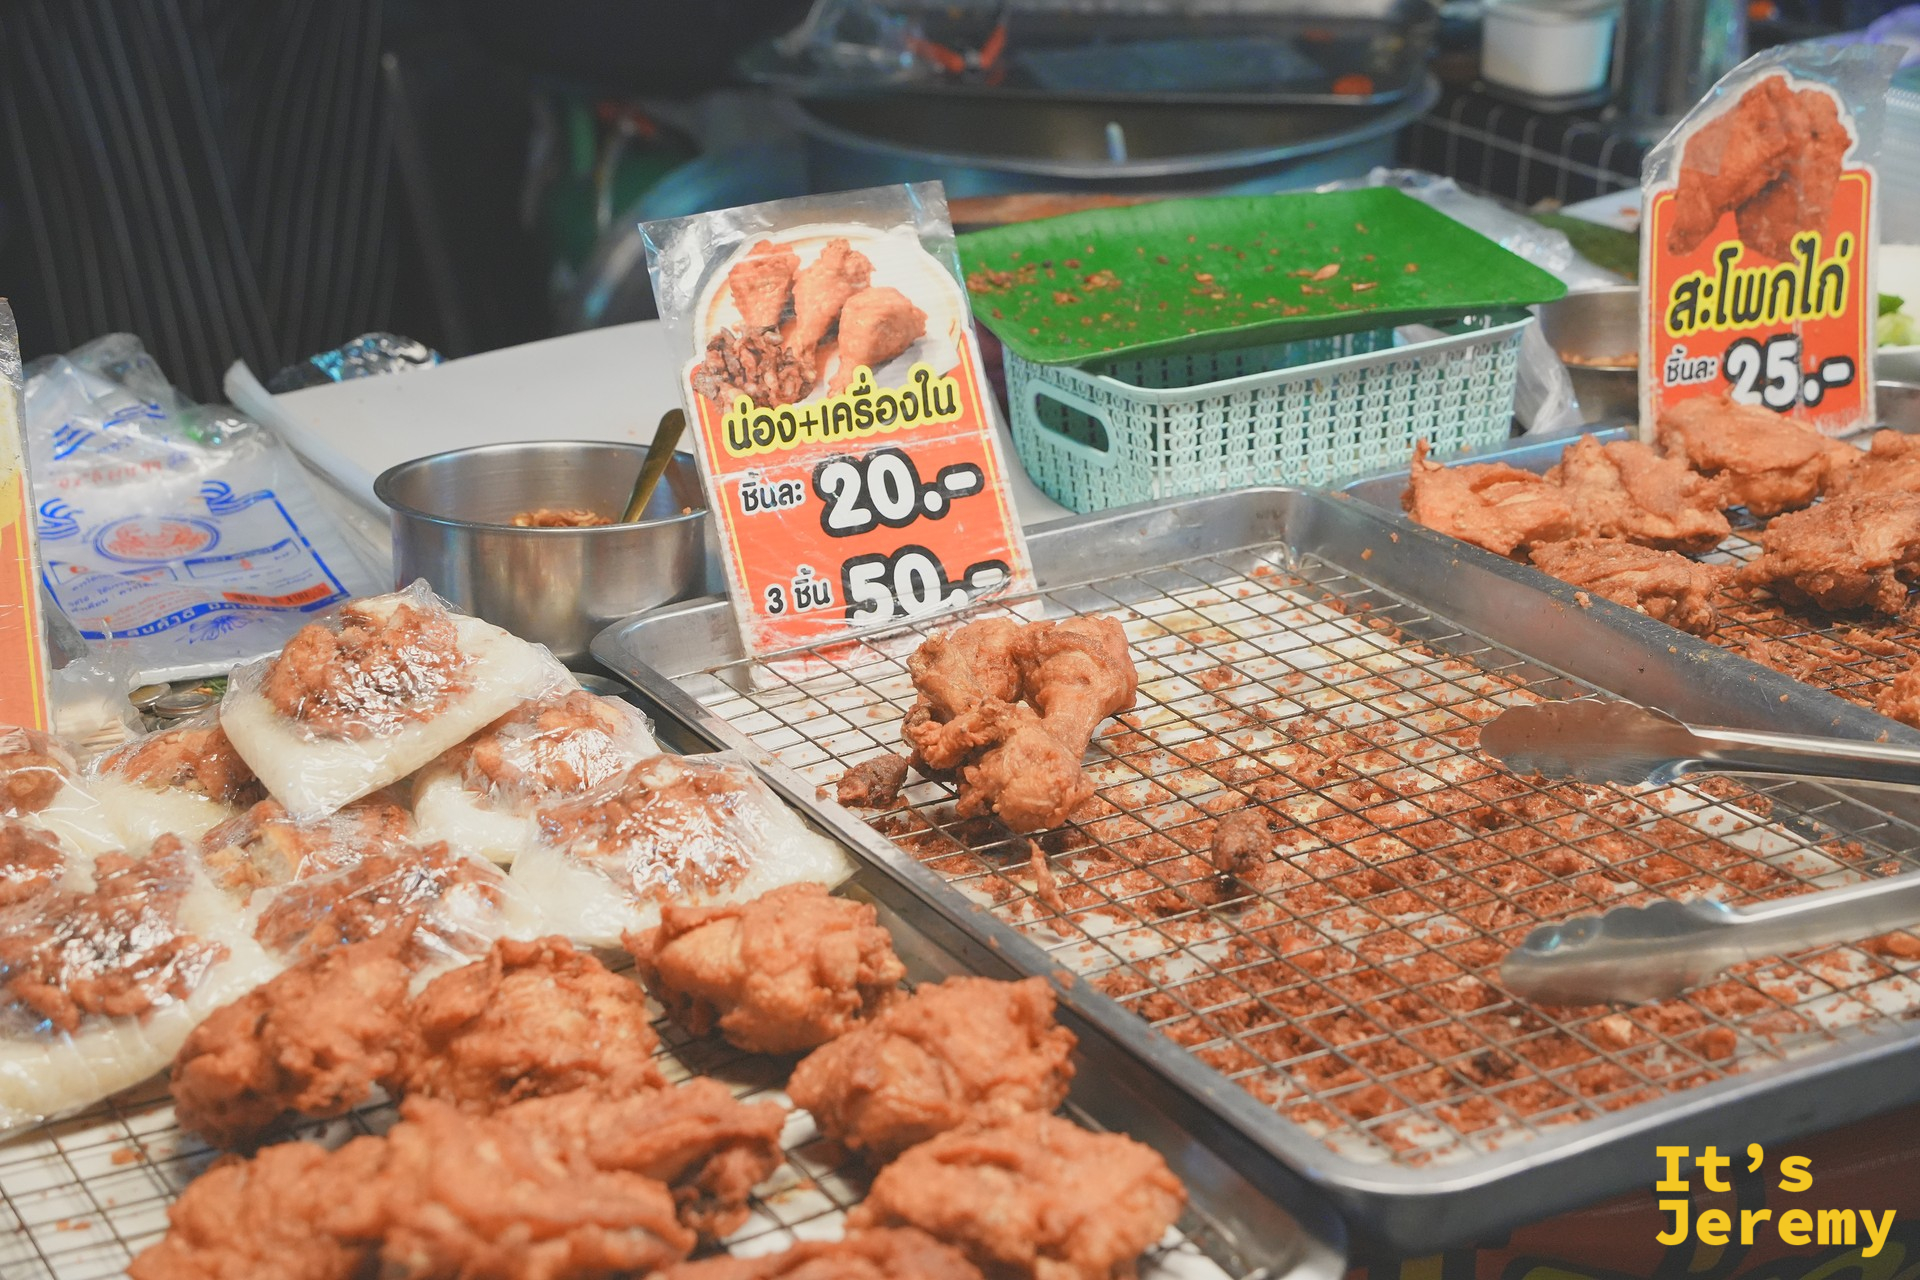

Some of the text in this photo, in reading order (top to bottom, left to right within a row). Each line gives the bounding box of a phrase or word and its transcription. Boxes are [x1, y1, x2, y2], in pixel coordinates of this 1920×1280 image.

[1670, 237, 1850, 331] สะโพกไก่
[728, 369, 957, 450] น่อง+เครื่องใน
[1665, 336, 1853, 408] ชิ้นละ 25.-
[741, 451, 981, 534] ชิ้นละ 20.-
[766, 587, 784, 614] 3
[794, 565, 831, 608] ชิ้น
